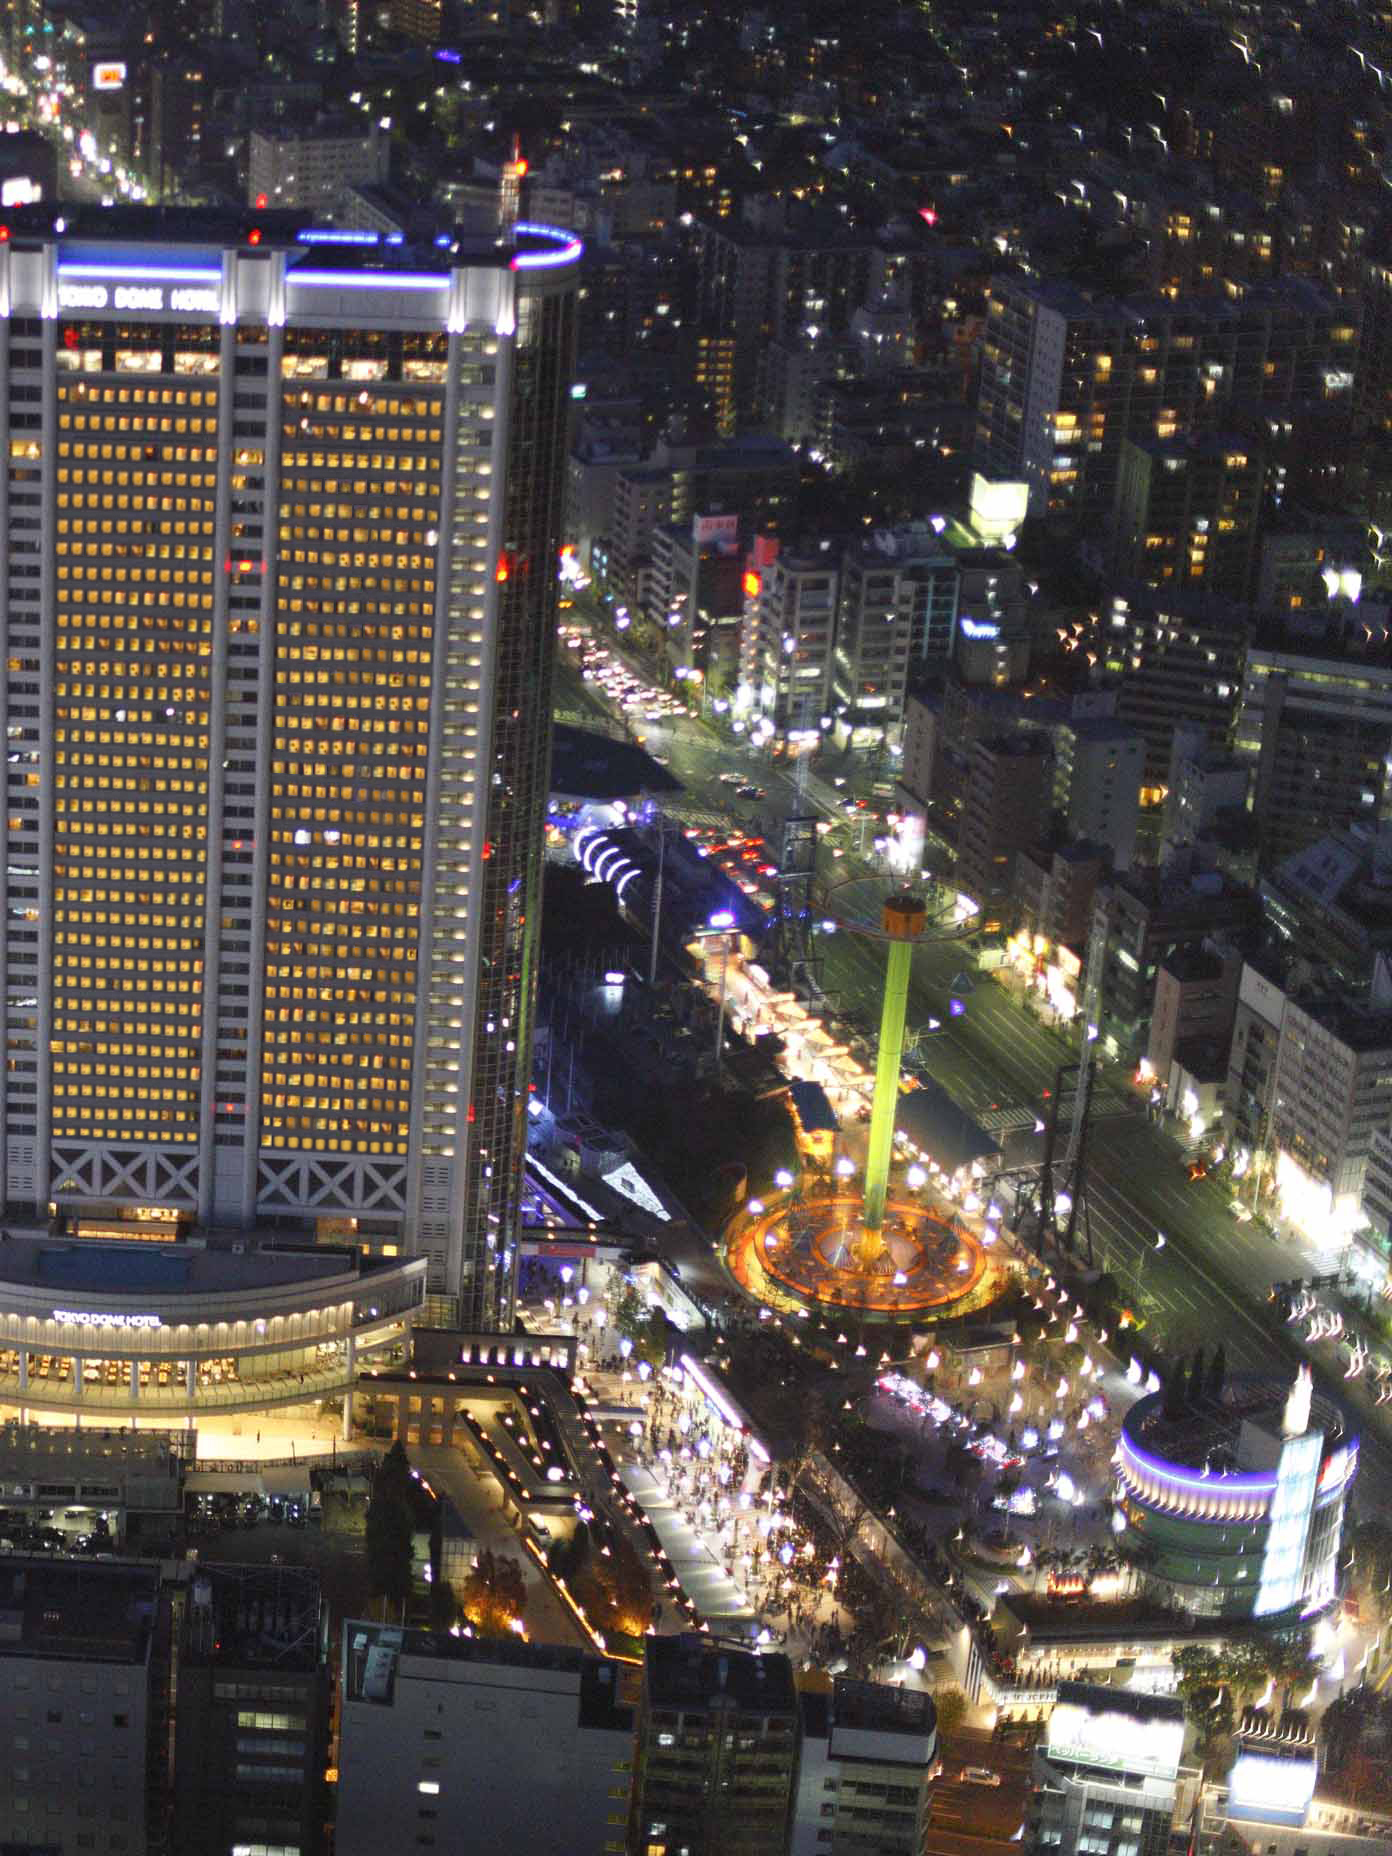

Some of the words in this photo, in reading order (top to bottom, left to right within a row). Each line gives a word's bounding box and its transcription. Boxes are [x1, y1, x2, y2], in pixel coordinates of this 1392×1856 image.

[53, 1310, 90, 1324] TOKYO
[90, 1313, 125, 1327] DOME
[126, 1315, 162, 1327] HOTEL
